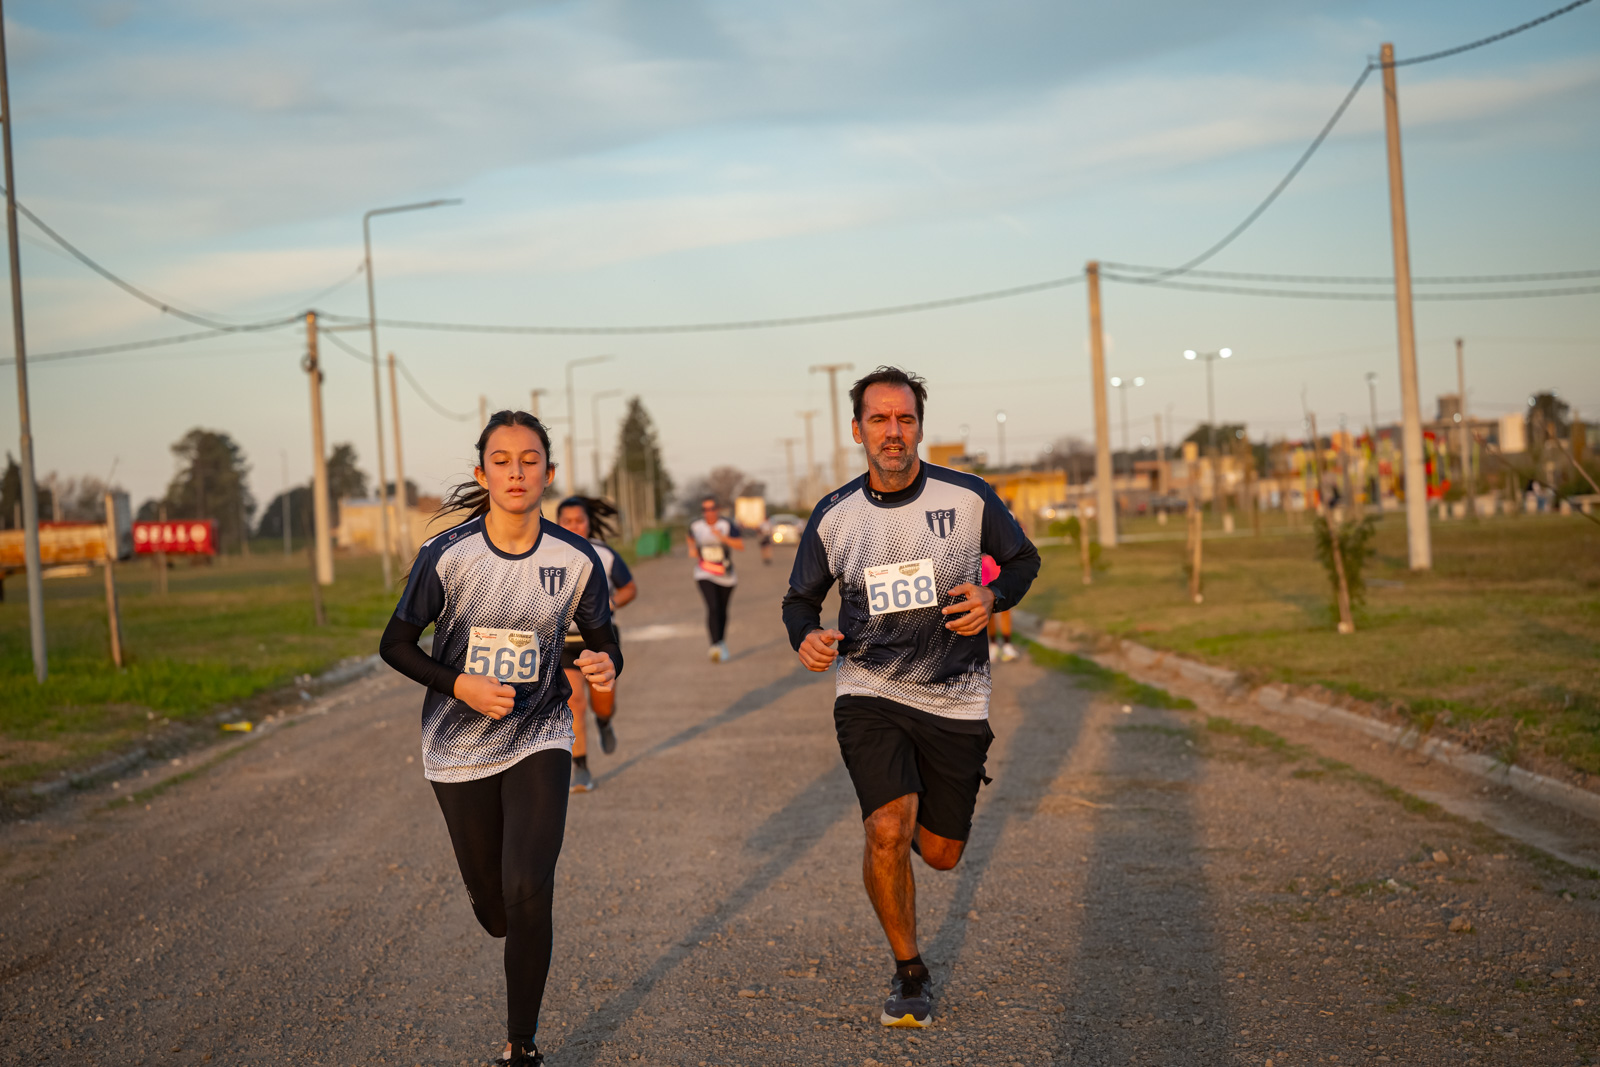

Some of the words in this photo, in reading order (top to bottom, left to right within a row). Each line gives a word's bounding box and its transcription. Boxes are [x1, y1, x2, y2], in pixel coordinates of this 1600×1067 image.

[931, 511, 951, 520] SFC
[543, 569, 562, 577] SFC
[869, 575, 934, 612] 568
[468, 645, 537, 679] 569
